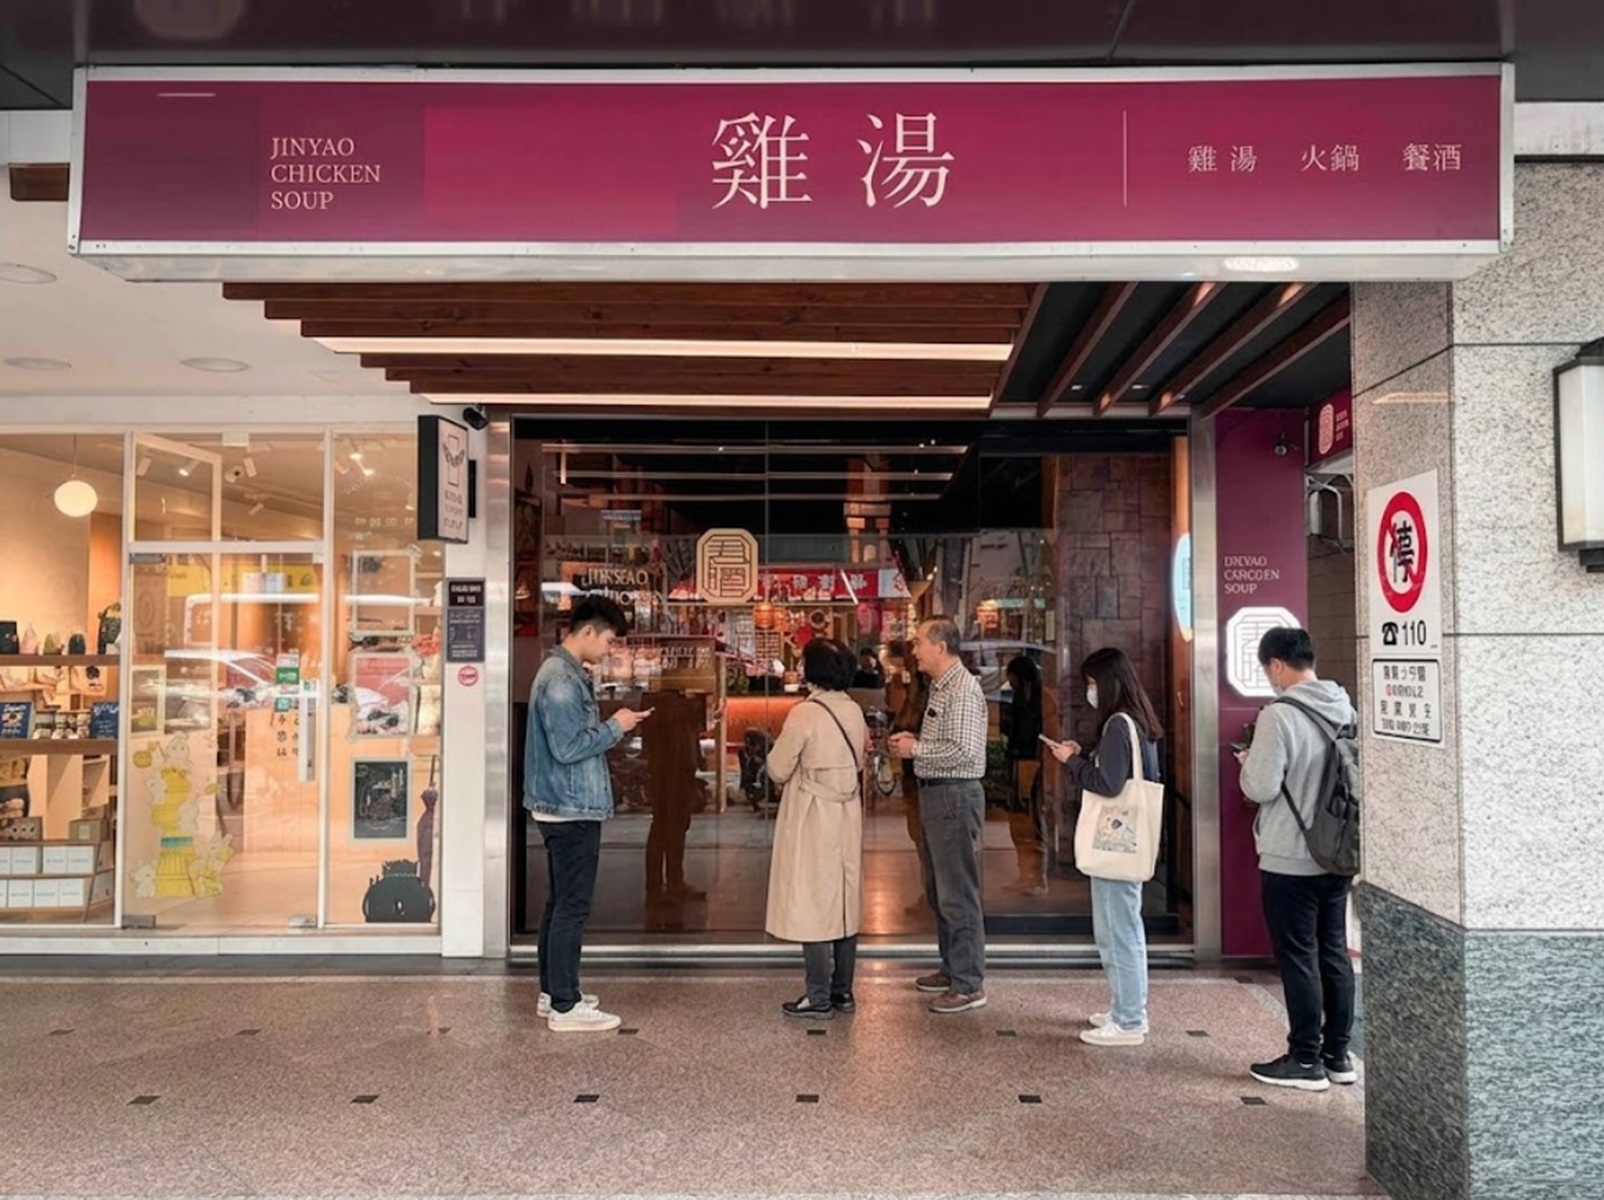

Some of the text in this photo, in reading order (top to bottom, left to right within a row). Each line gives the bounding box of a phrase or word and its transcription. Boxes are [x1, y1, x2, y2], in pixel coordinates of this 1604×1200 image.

[270, 137, 355, 160] JINYAO
[1188, 143, 1462, 173] 雞湯 火鍋 餐酒
[711, 111, 955, 210] 雞湯
[270, 164, 381, 184] CHICKEN
[270, 191, 334, 211] SOUP
[1224, 583, 1258, 594] SOUP
[1402, 619, 1427, 646] 110
